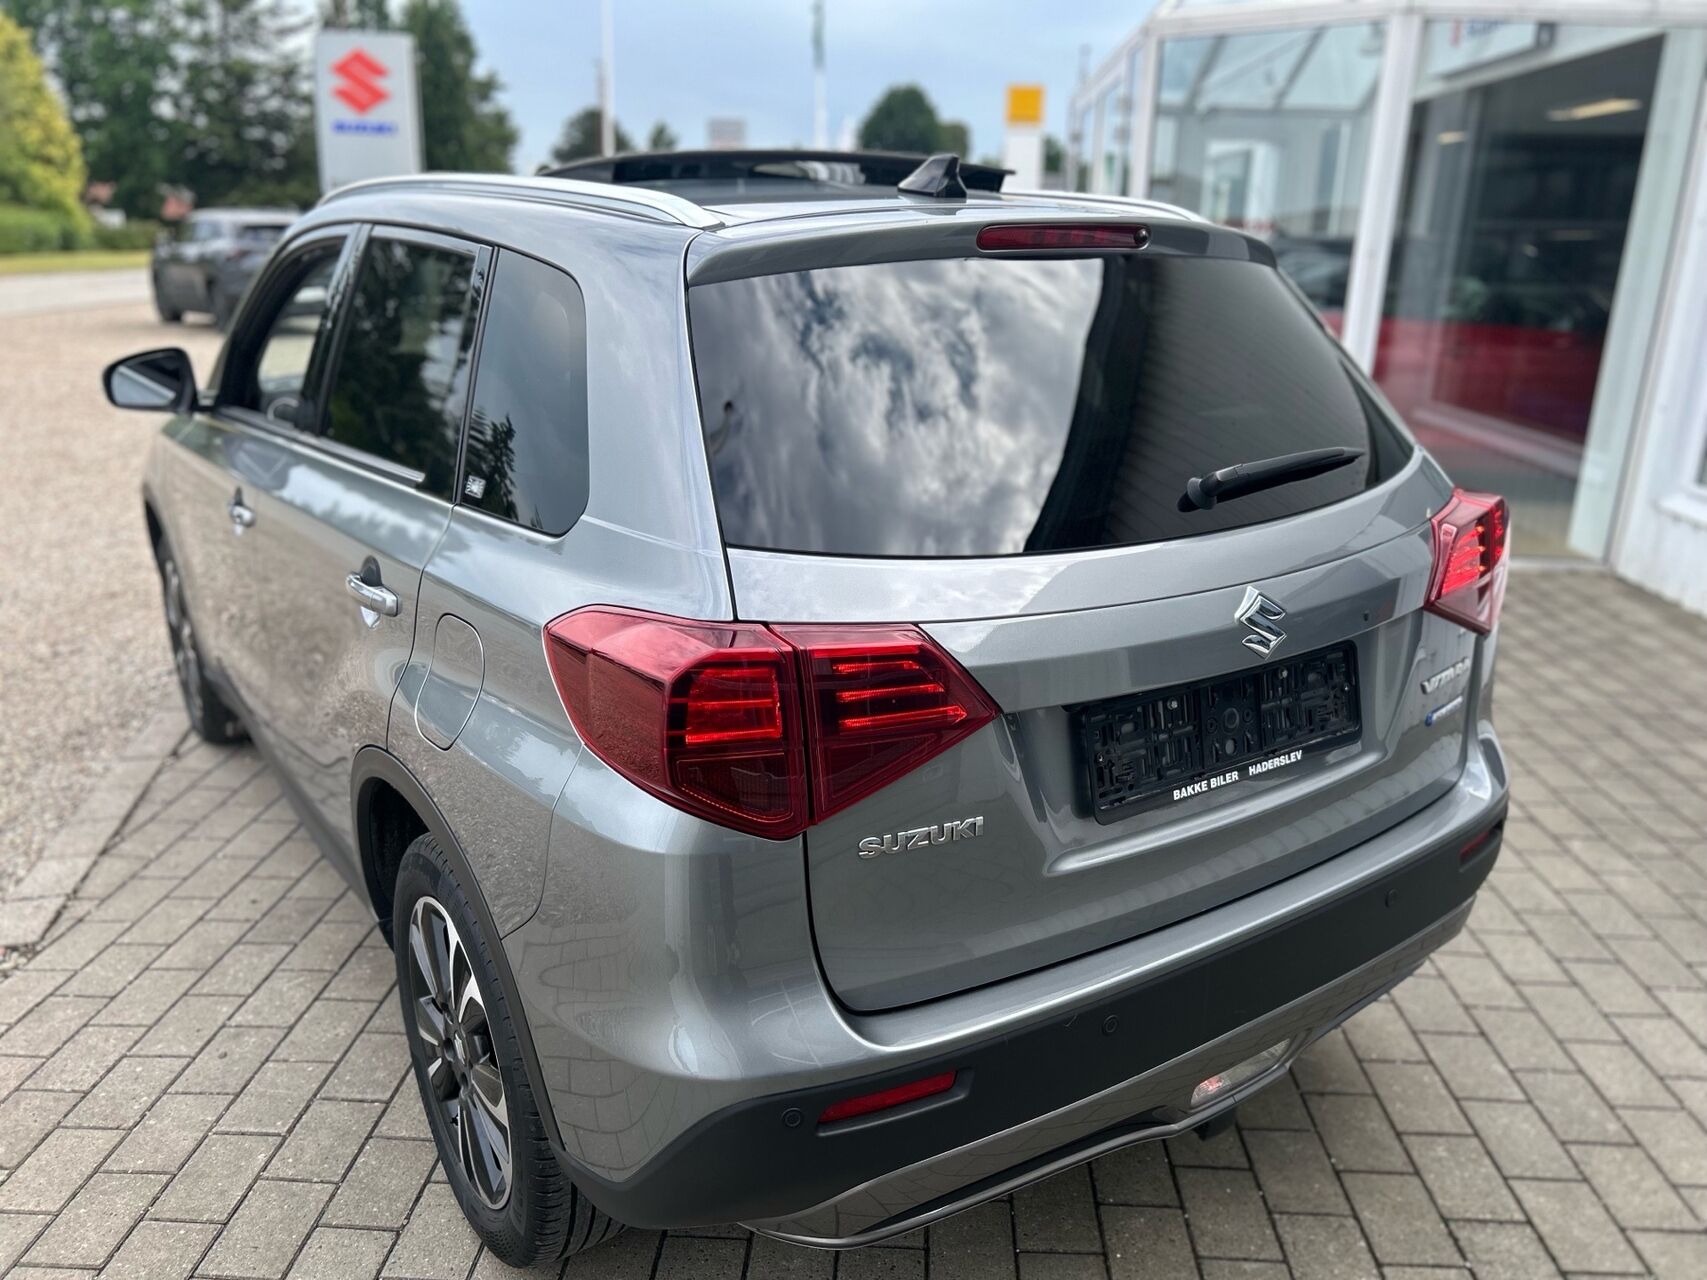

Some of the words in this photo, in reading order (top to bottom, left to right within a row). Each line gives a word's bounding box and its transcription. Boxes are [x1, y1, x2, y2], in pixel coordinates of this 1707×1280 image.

[1173, 781, 1208, 801] BAKKE
[1210, 771, 1239, 789] BILER
[1248, 750, 1302, 776] HADERSLEV
[858, 816, 984, 859] SUZUKI
